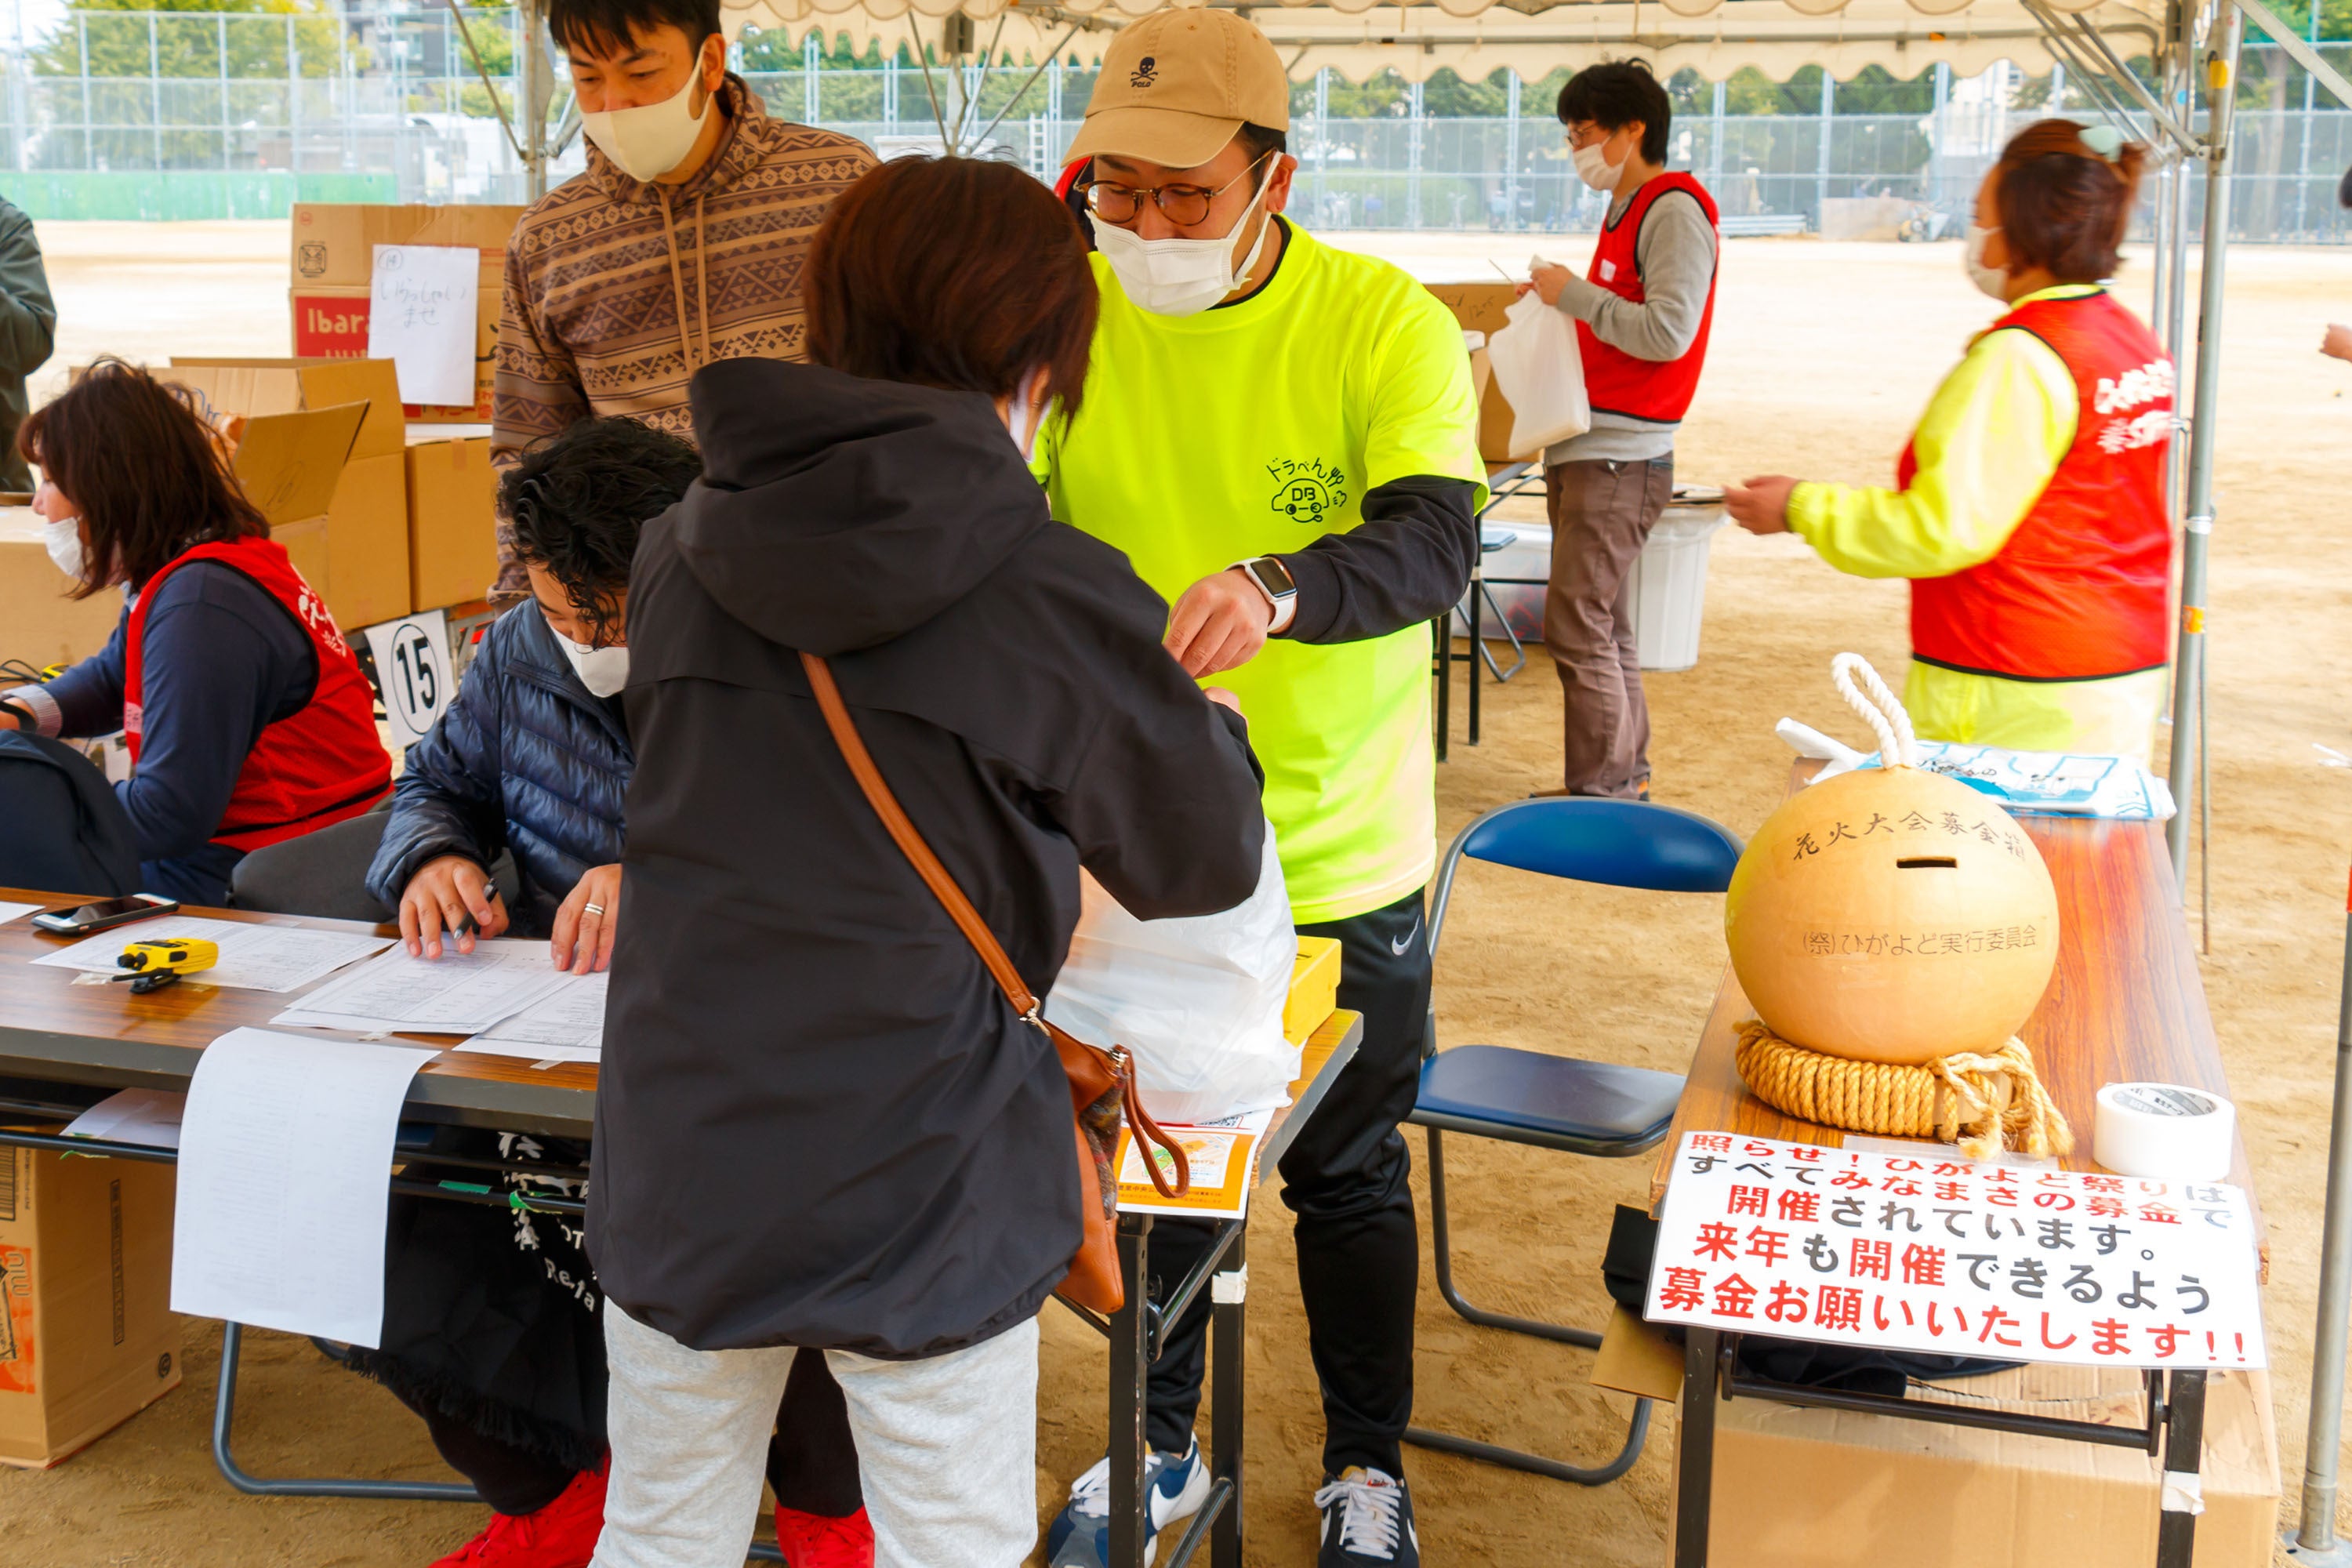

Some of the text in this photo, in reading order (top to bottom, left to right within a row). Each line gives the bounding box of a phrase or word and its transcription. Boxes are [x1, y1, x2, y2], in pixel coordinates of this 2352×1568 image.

[307, 307, 368, 334] Ibar
[403, 303, 440, 328] ませ
[396, 636, 436, 714] 15
[1726, 1183, 2156, 1261] 開催されています。
[1693, 1220, 2211, 1315] 来年も開催できるよう
